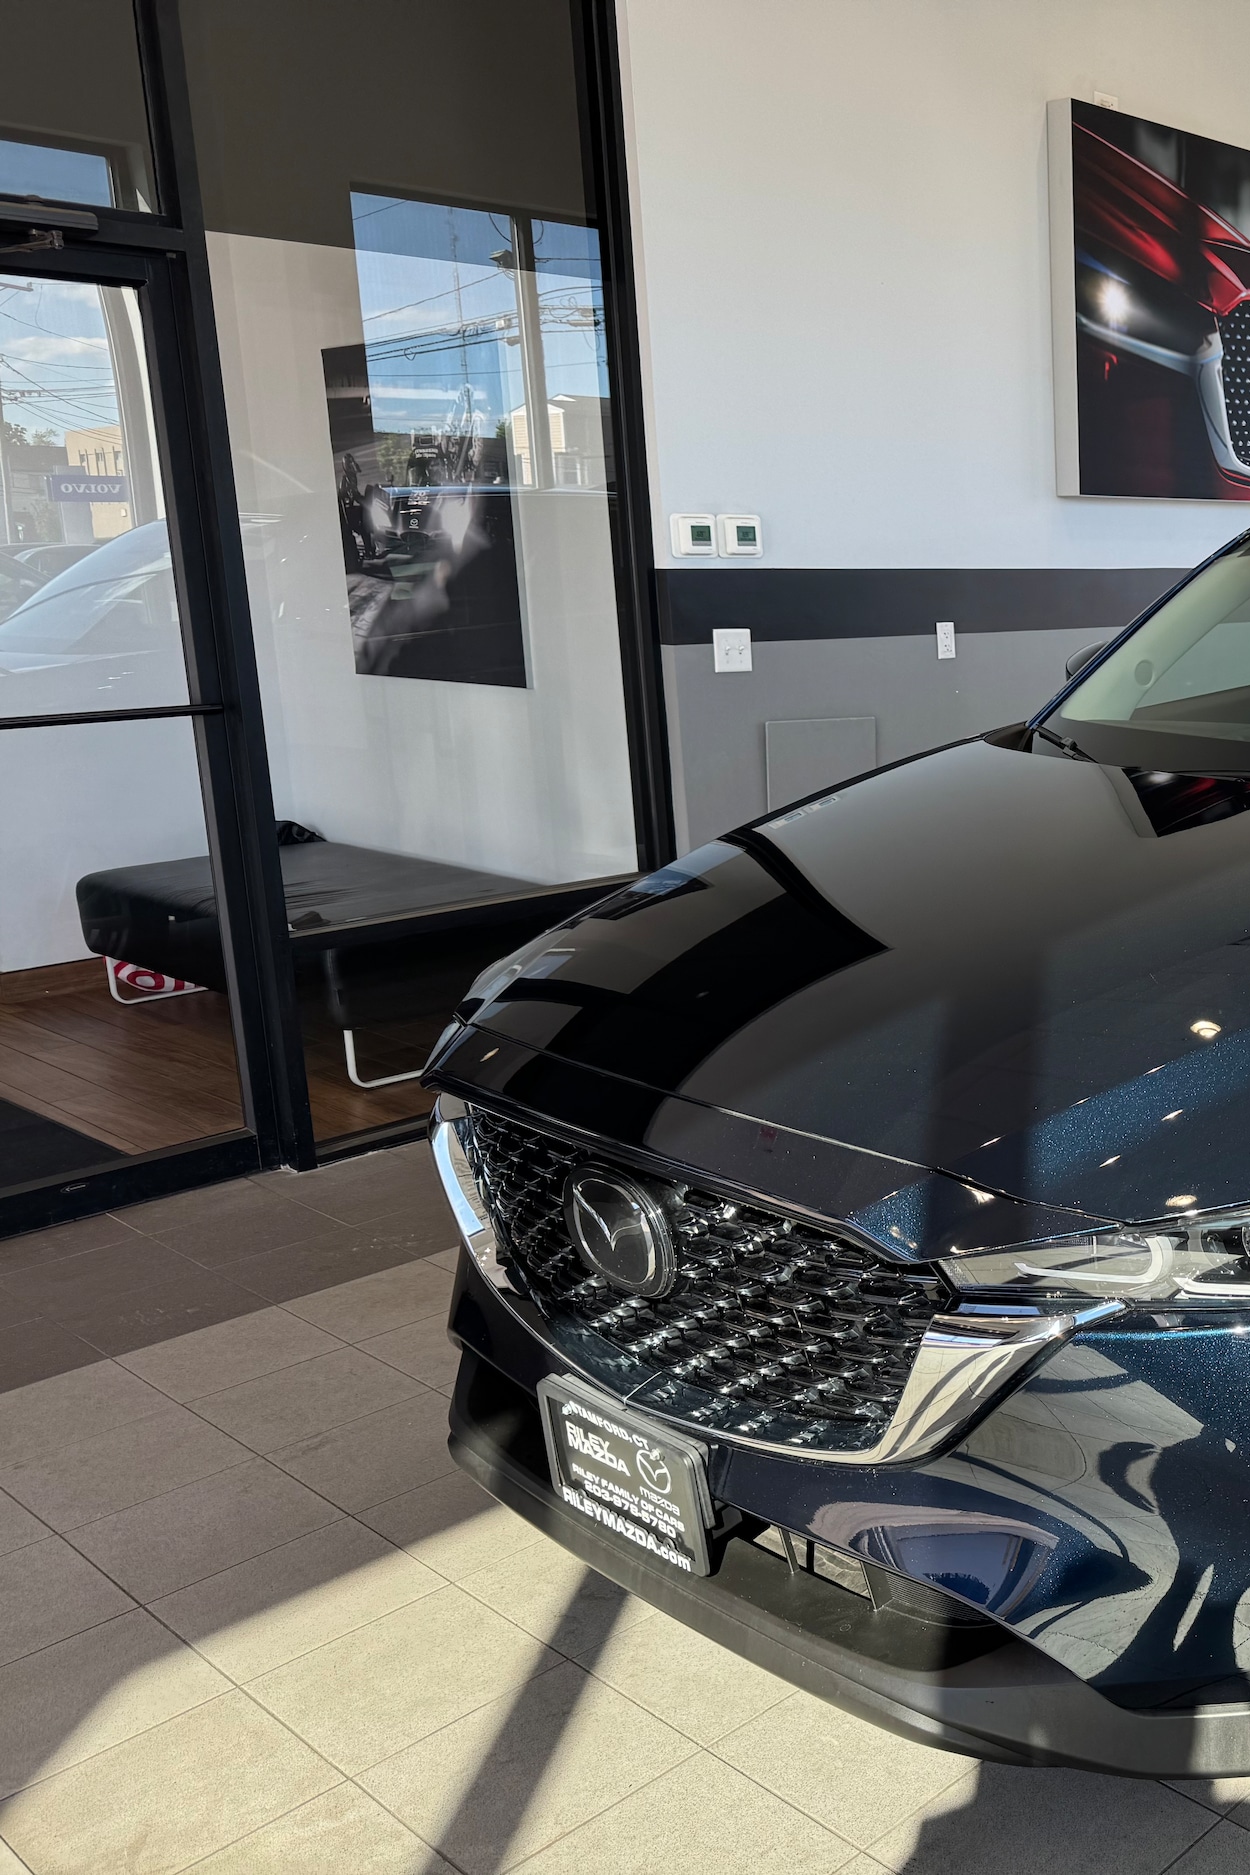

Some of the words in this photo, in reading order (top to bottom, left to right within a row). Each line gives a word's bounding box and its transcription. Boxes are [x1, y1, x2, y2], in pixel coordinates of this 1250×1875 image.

[564, 1420, 611, 1453] RILEY
[567, 1434, 632, 1477] MAZDA
[631, 1433, 650, 1451] CT
[572, 1463, 600, 1484] RILEY
[600, 1478, 640, 1505] FAMILY
[640, 1499, 655, 1513] OF
[654, 1508, 686, 1533] CARS
[583, 1479, 677, 1539] 203-878-5780
[562, 1486, 692, 1571] RILEYMAZDA.com
